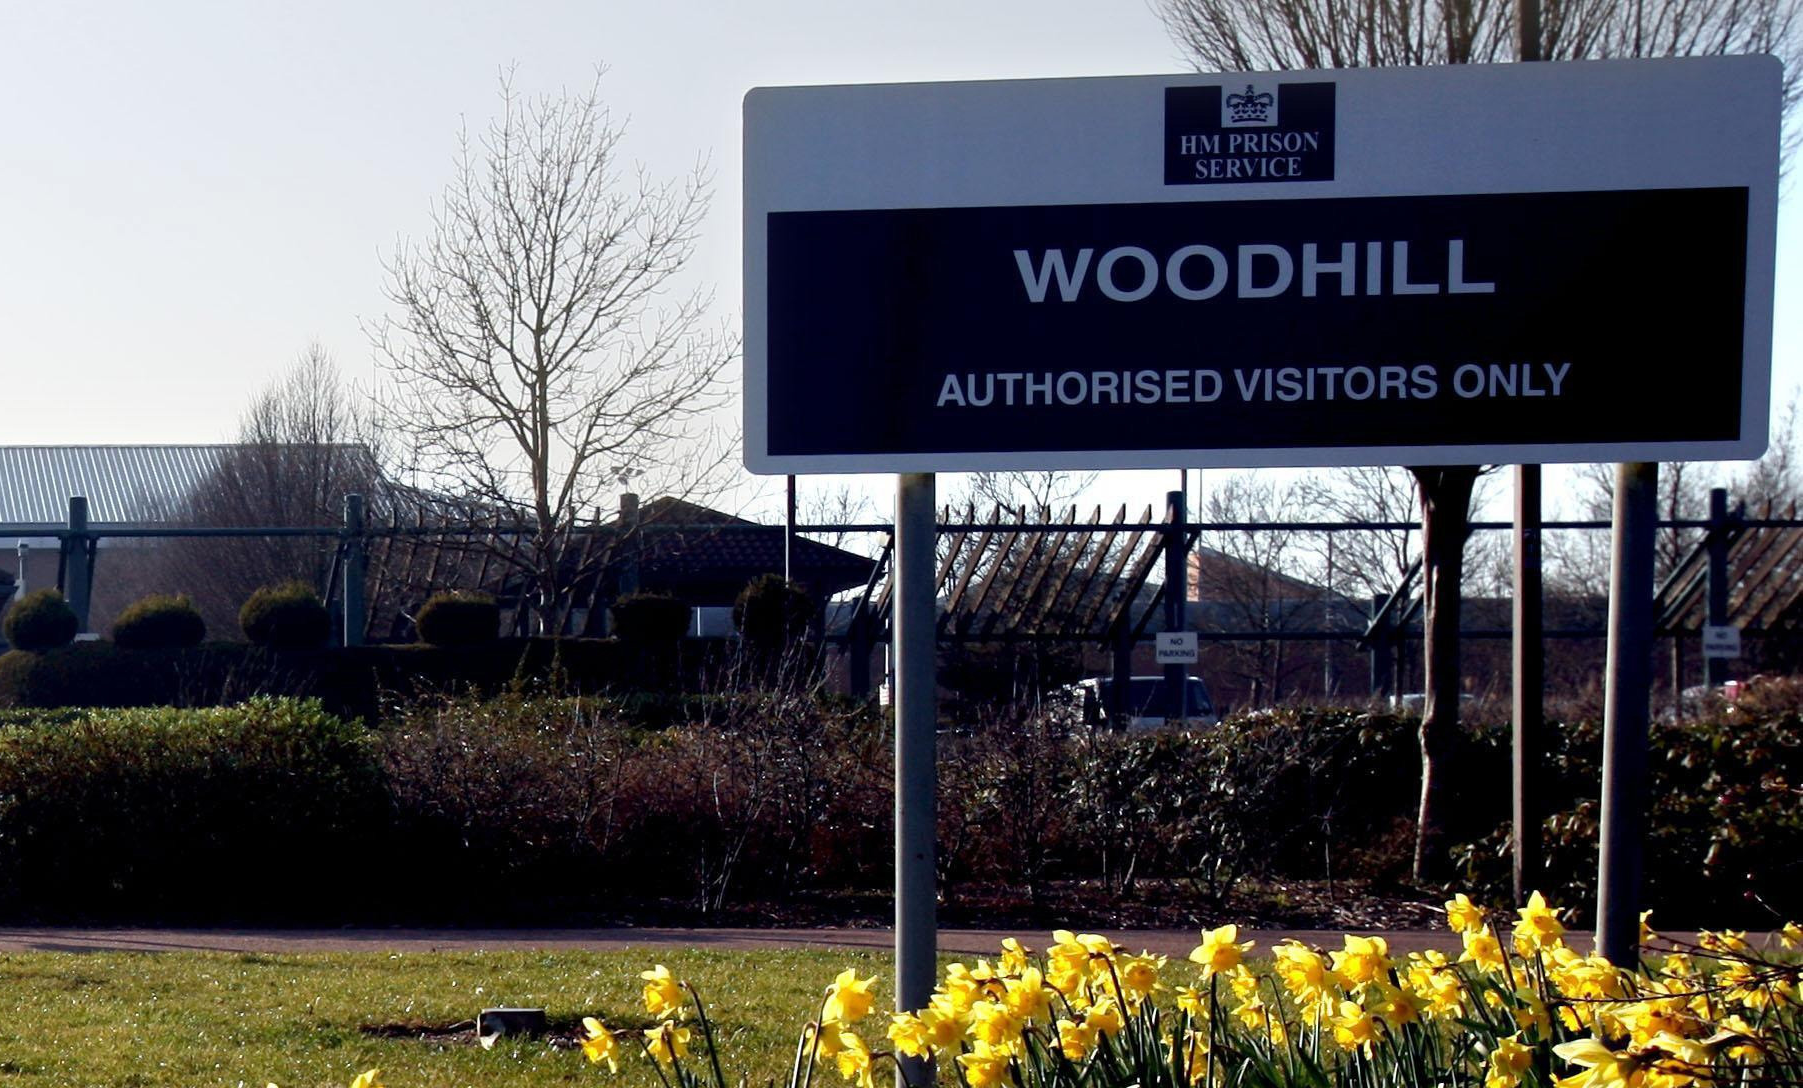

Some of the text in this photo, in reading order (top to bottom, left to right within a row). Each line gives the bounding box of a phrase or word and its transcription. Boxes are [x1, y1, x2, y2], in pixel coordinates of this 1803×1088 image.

[1180, 131, 1320, 155] HM PRISON
[1195, 157, 1302, 179] SERVICE
[1012, 239, 1495, 302] WOODHILL
[936, 362, 1571, 407] AUTHORISED VISITORS ONLY
[1158, 648, 1195, 657] PARKING
